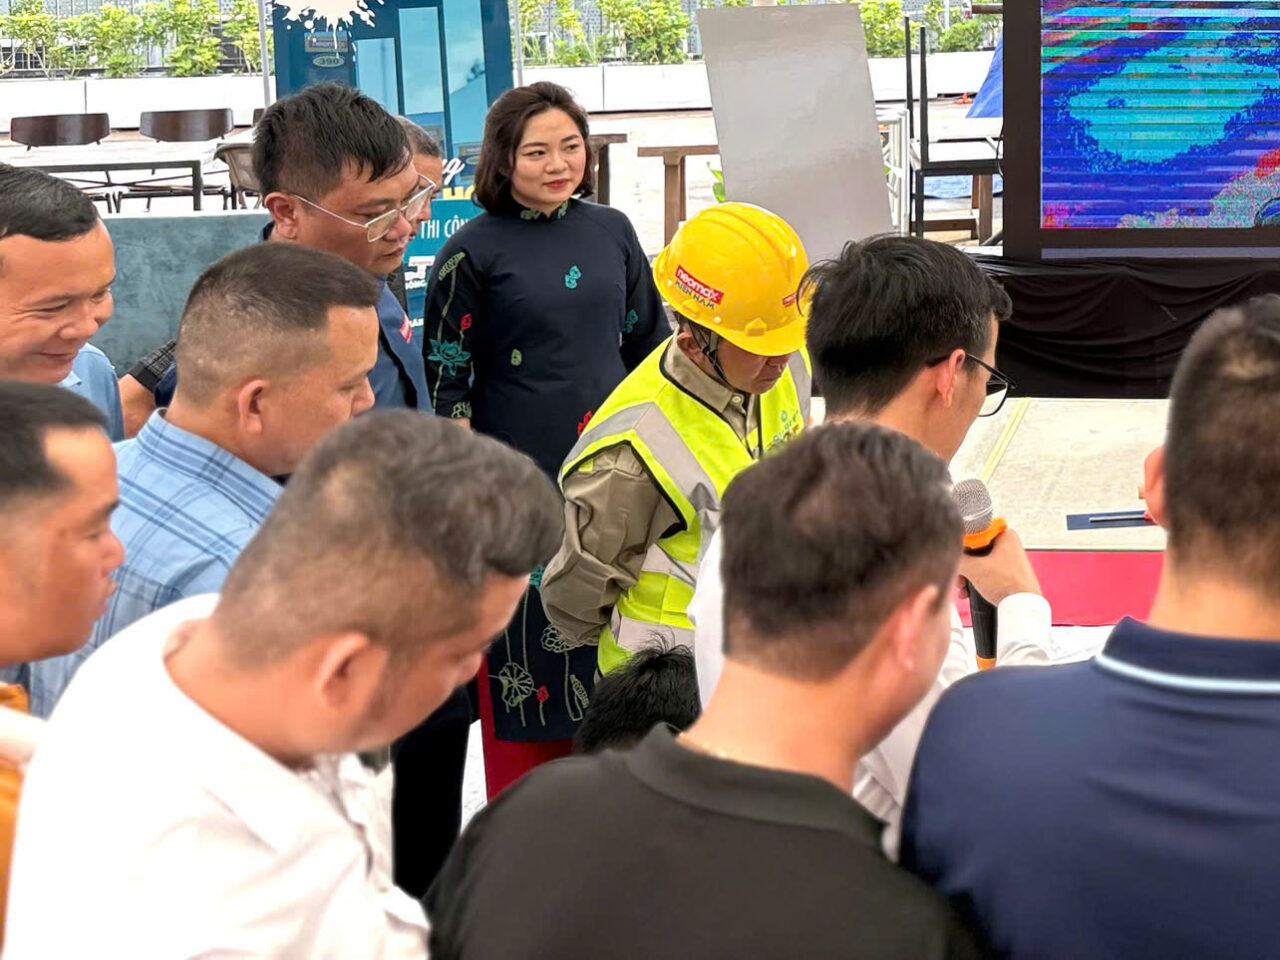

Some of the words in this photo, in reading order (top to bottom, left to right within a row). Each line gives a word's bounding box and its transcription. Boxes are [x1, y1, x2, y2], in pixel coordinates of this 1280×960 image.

[420, 218, 440, 239] THI
[443, 214, 470, 239] CÔN
[677, 268, 721, 302] neomax
